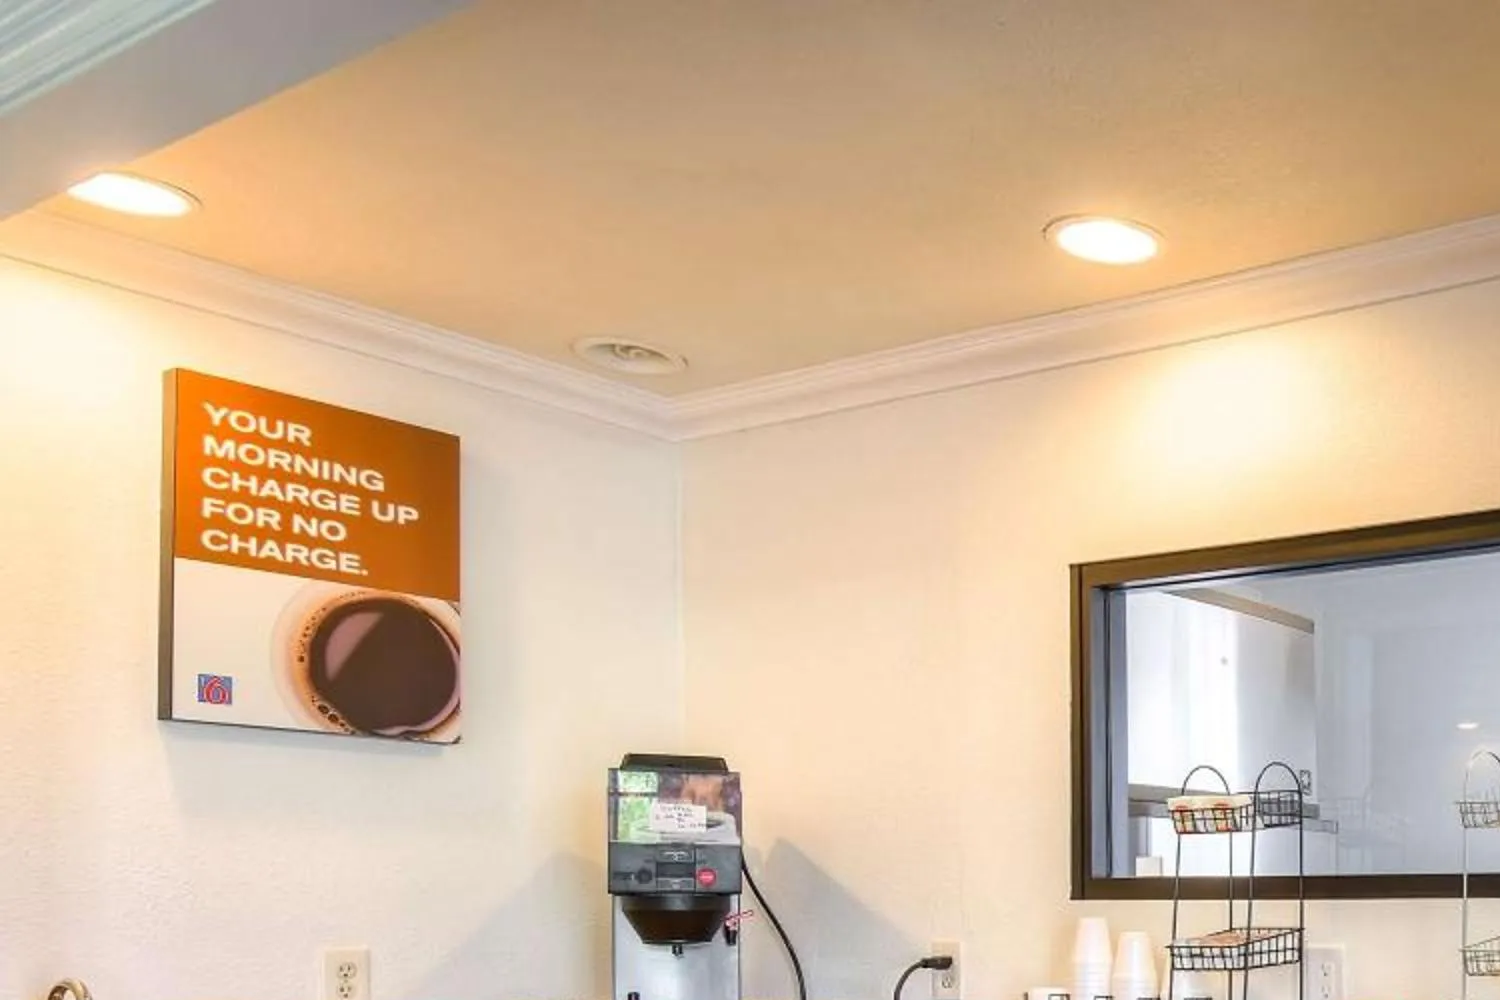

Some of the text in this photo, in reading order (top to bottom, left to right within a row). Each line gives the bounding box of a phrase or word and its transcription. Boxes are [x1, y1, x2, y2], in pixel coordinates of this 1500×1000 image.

[203, 401, 311, 446] YOUR
[203, 434, 385, 491] MORNING
[202, 467, 419, 525] CHARGE UP
[202, 497, 347, 541] FOR NO
[201, 529, 368, 575] CHARGE.
